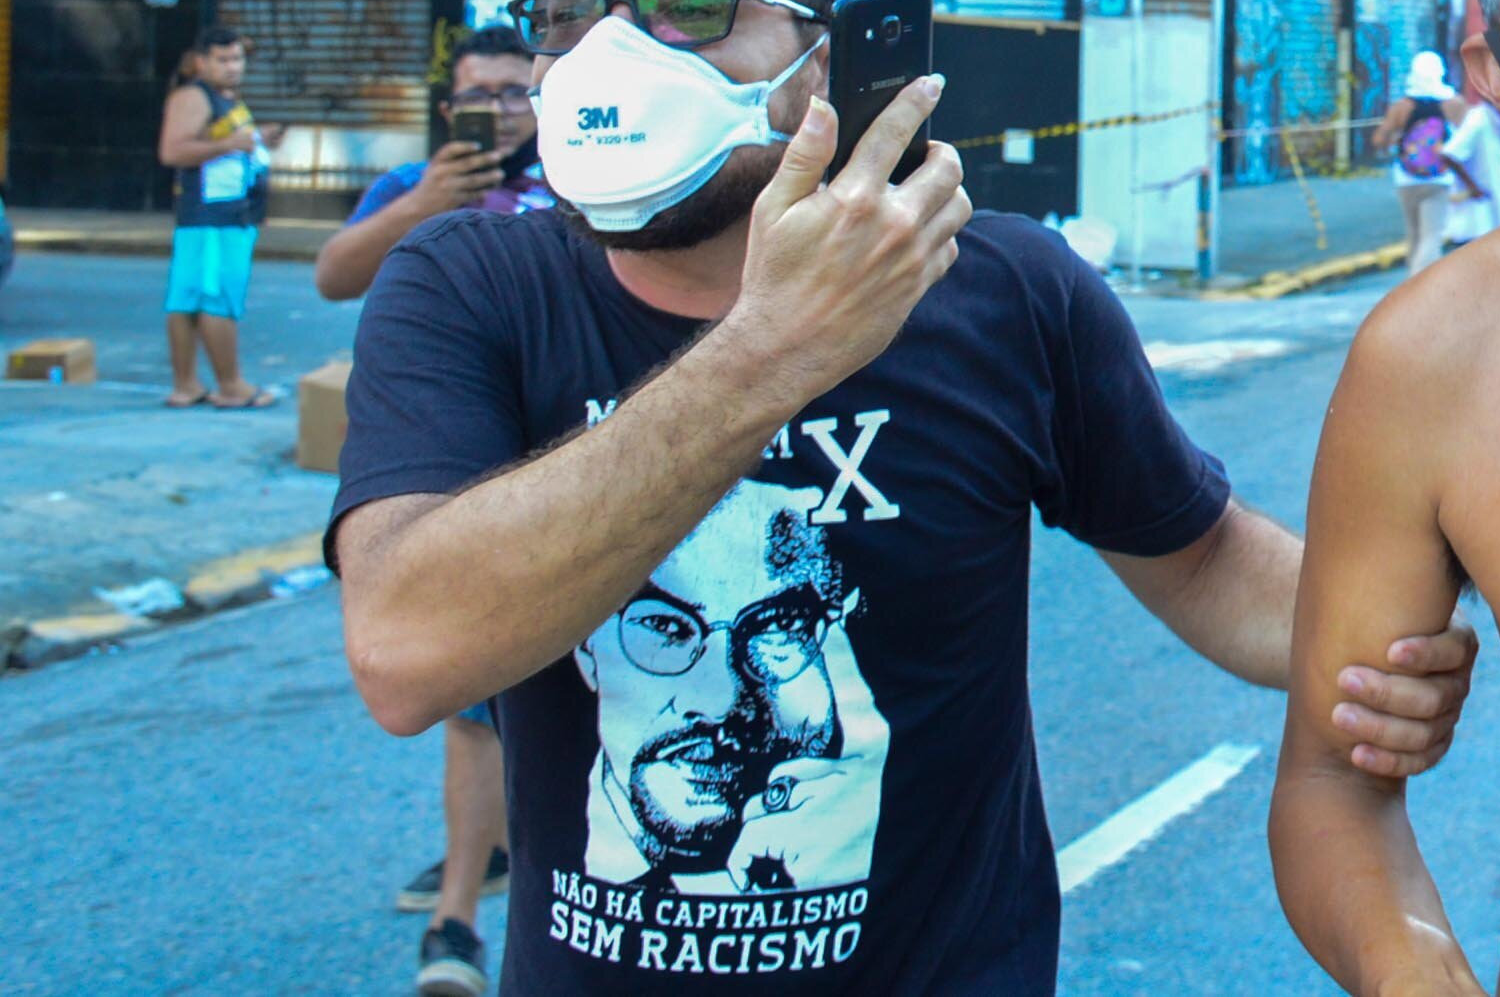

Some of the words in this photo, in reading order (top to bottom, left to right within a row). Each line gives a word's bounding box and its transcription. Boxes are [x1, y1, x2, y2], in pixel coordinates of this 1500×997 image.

[577, 105, 619, 130] 3M
[801, 408, 900, 525] X
[551, 868, 598, 909] NÃO
[604, 889, 645, 923] HÁ
[655, 887, 869, 929] CAPITALISMO
[549, 900, 625, 963] SEM
[637, 921, 863, 974] RACISMO
